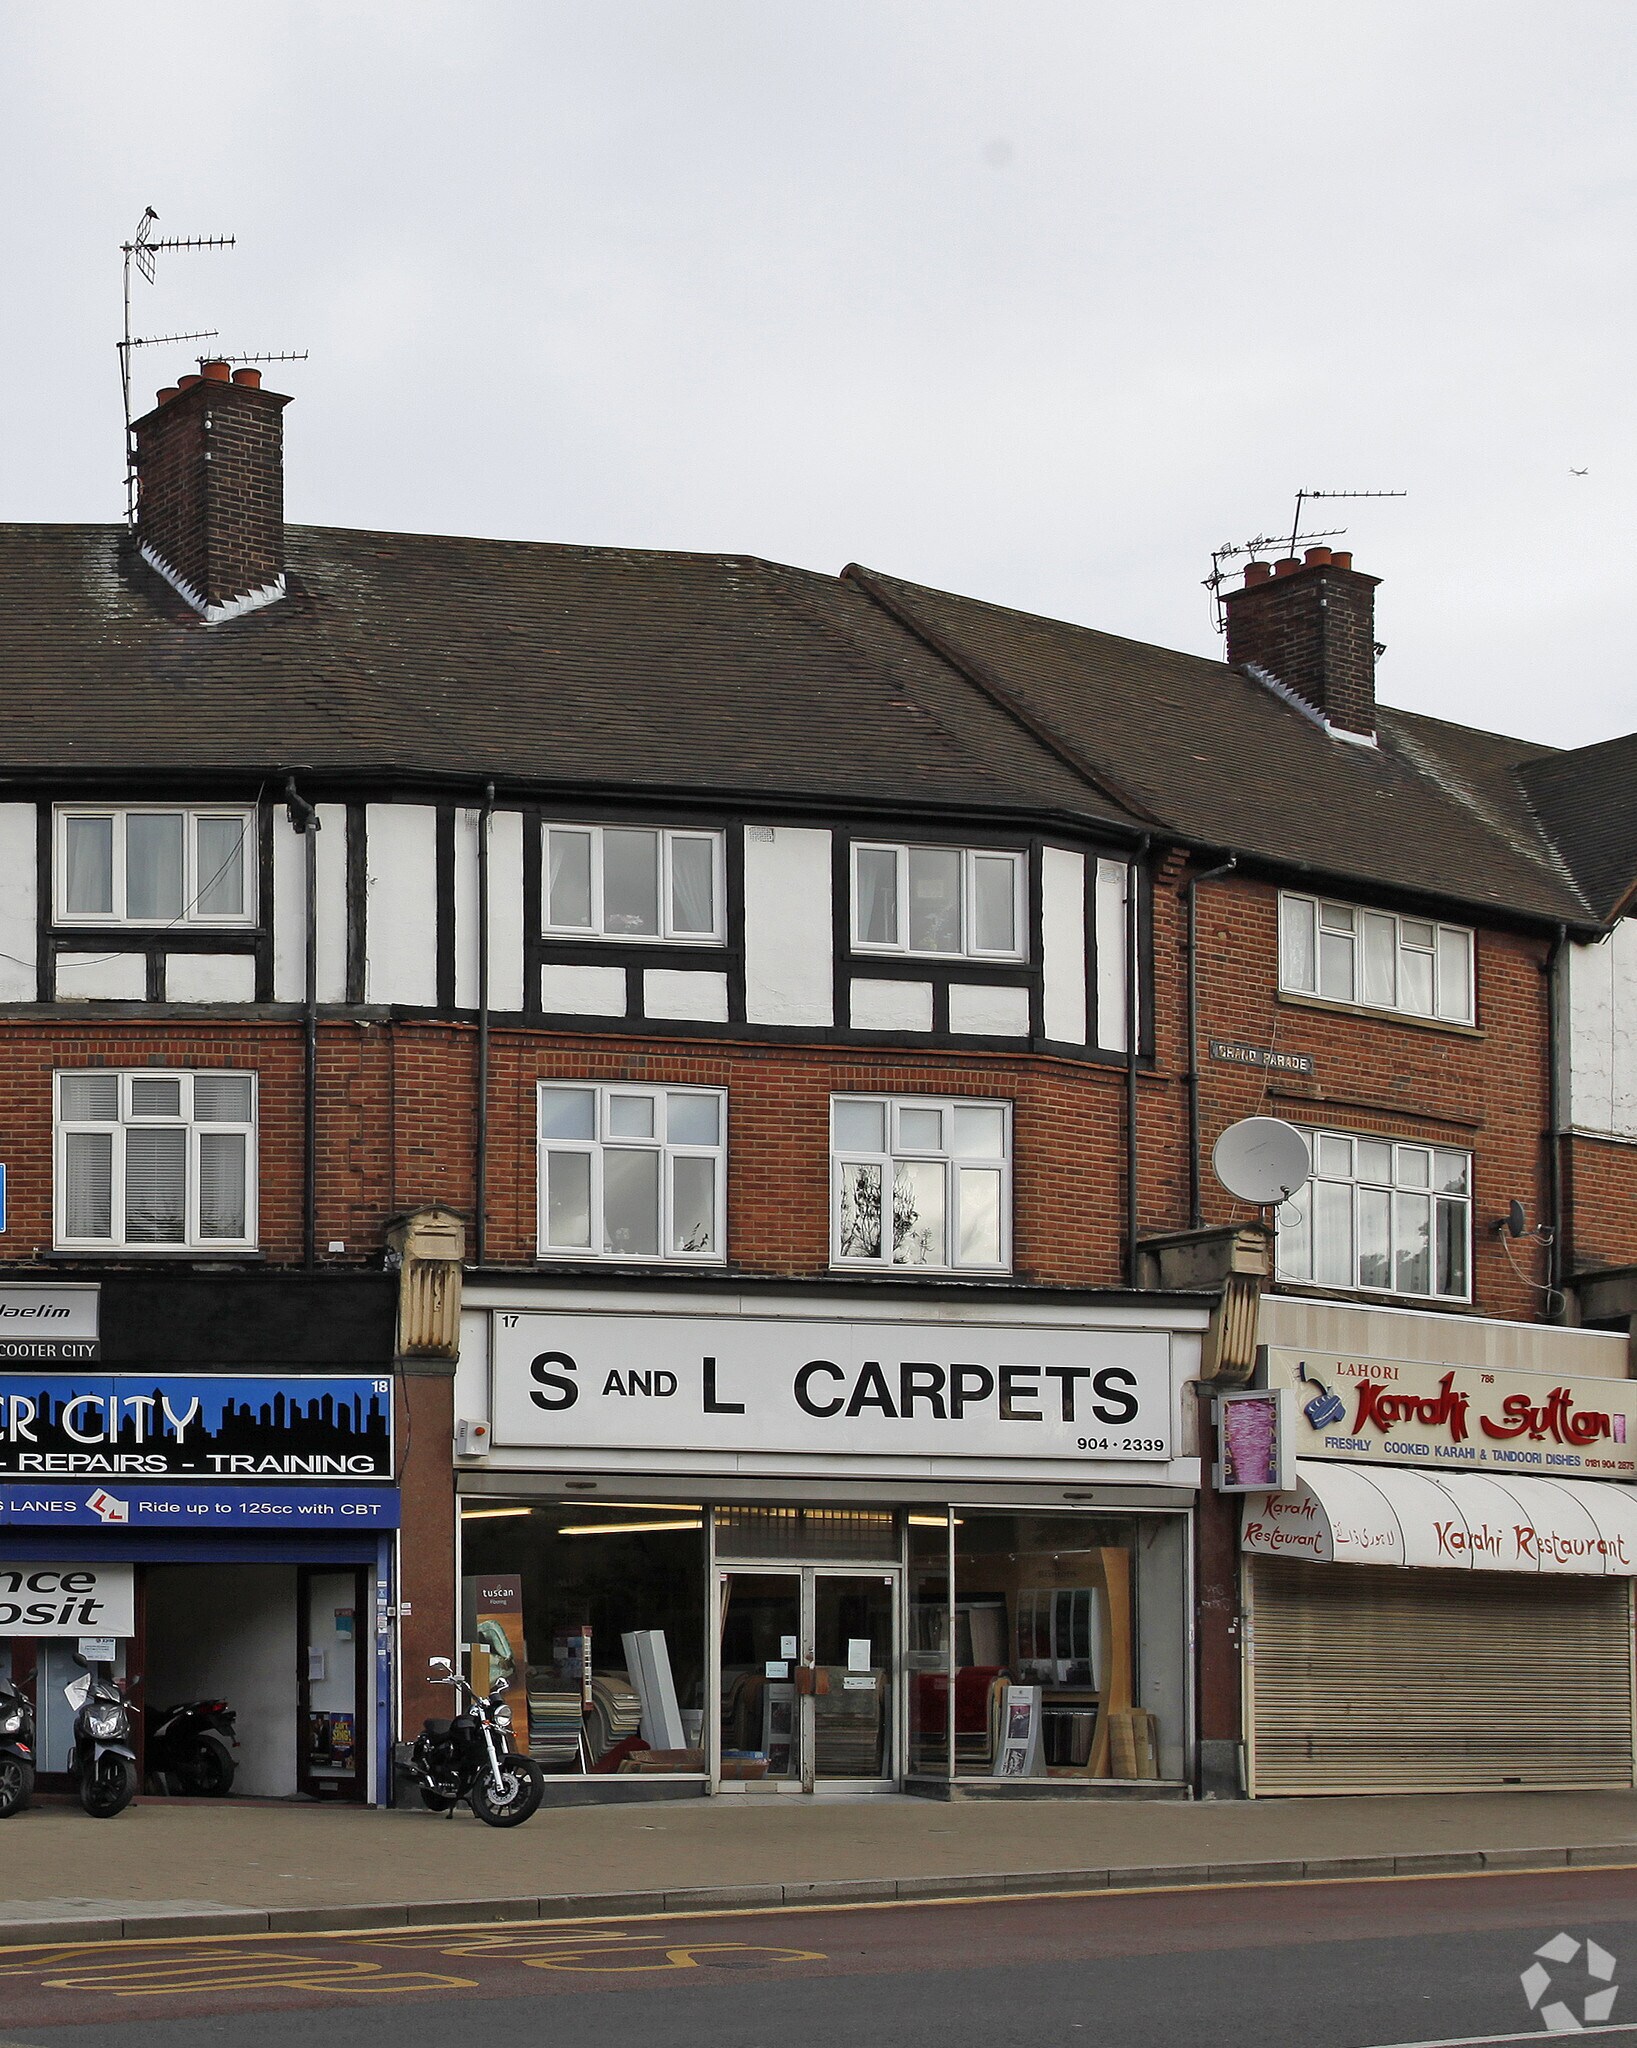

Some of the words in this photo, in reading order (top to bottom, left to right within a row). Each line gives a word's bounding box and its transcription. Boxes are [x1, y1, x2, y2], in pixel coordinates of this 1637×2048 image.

[1218, 1045, 1257, 1062] GRAND
[1262, 1052, 1308, 1070] PARADE
[502, 1315, 519, 1328] 17
[62, 1344, 96, 1357] CITY
[1336, 1362, 1399, 1380] LAHORI
[1480, 1373, 1495, 1384] 786
[371, 1380, 388, 1393] 18
[529, 1351, 579, 1411] S
[602, 1369, 678, 1397] AND
[703, 1357, 745, 1414] L
[793, 1359, 1140, 1425] CARPETS
[1352, 1371, 1470, 1443] Karahi
[1480, 1387, 1611, 1446] Sultan
[62, 1395, 199, 1444] CITY
[1325, 1436, 1372, 1451] FRESHLY
[1384, 1441, 1430, 1456] COOKED
[1435, 1446, 1476, 1459] KARAHI
[1480, 1449, 1487, 1460] &
[1492, 1450, 1542, 1464] TANDOORI
[1546, 1454, 1581, 1467] DISHES
[18, 1453, 168, 1473] REPAIRS
[206, 1454, 375, 1473] TRAINING
[1585, 1459, 1600, 1468] 0181
[1602, 1459, 1616, 1469] 904
[1617, 1460, 1635, 1470] 2875
[10, 1501, 77, 1512] LANES
[138, 1502, 181, 1513] Ride
[187, 1504, 209, 1515] up
[214, 1503, 232, 1513] to
[239, 1503, 293, 1514] 125cc
[298, 1504, 334, 1514] with
[340, 1504, 381, 1515] CBT
[1262, 1494, 1318, 1520] Karahi
[1243, 1522, 1323, 1554] Restaurant
[1433, 1521, 1503, 1560] Karahi
[1512, 1525, 1631, 1565] Restaurant
[482, 1588, 514, 1598] tuscan
[343, 1929, 829, 1972] BUS
